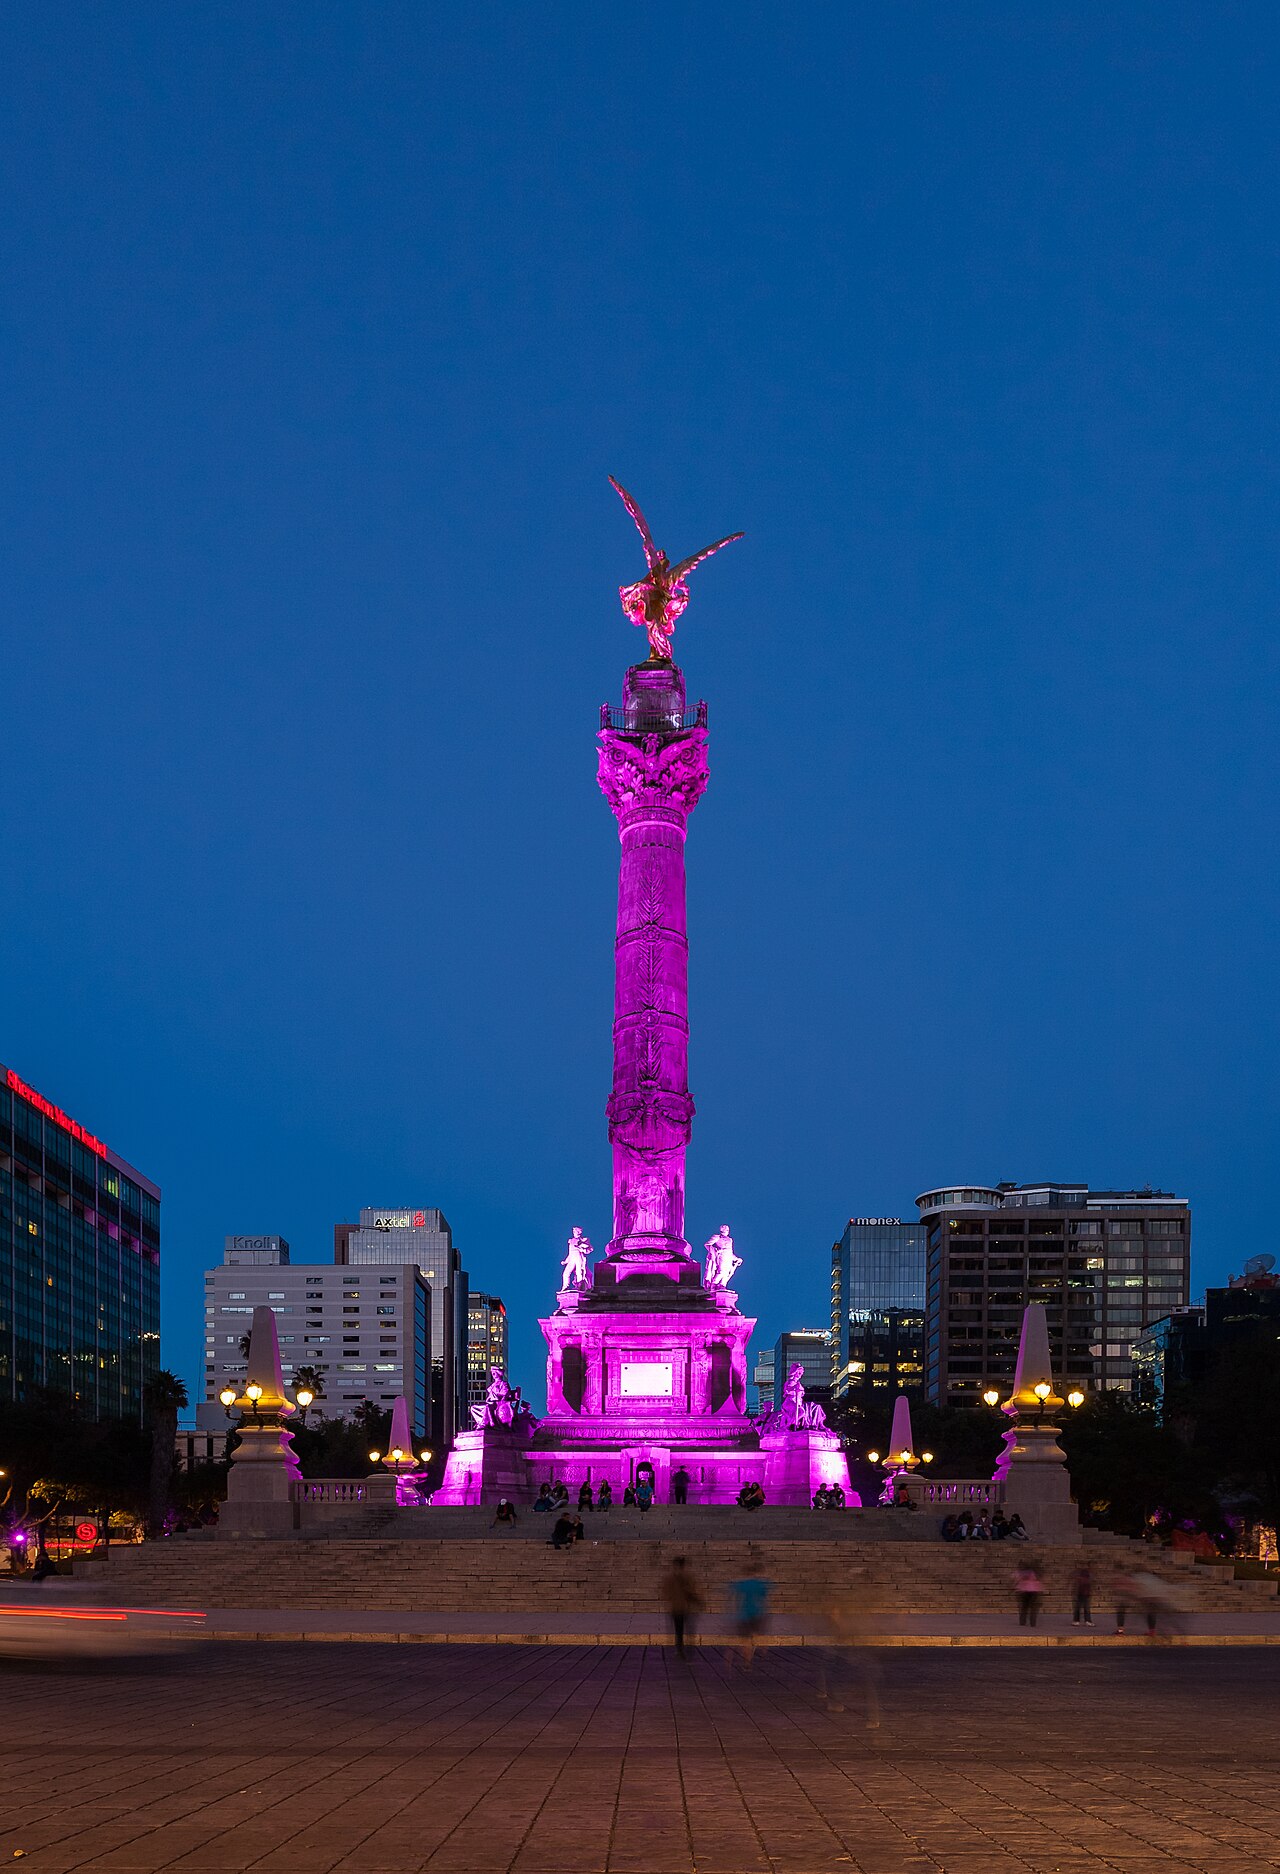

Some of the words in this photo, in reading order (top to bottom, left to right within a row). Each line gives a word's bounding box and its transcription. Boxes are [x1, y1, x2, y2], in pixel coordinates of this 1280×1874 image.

[7, 1069, 54, 1119] Sheraton
[54, 1105, 80, 1140] Maria
[81, 1126, 107, 1159] Isabel
[857, 1217, 901, 1225] monex
[233, 1236, 270, 1248] Knoll
